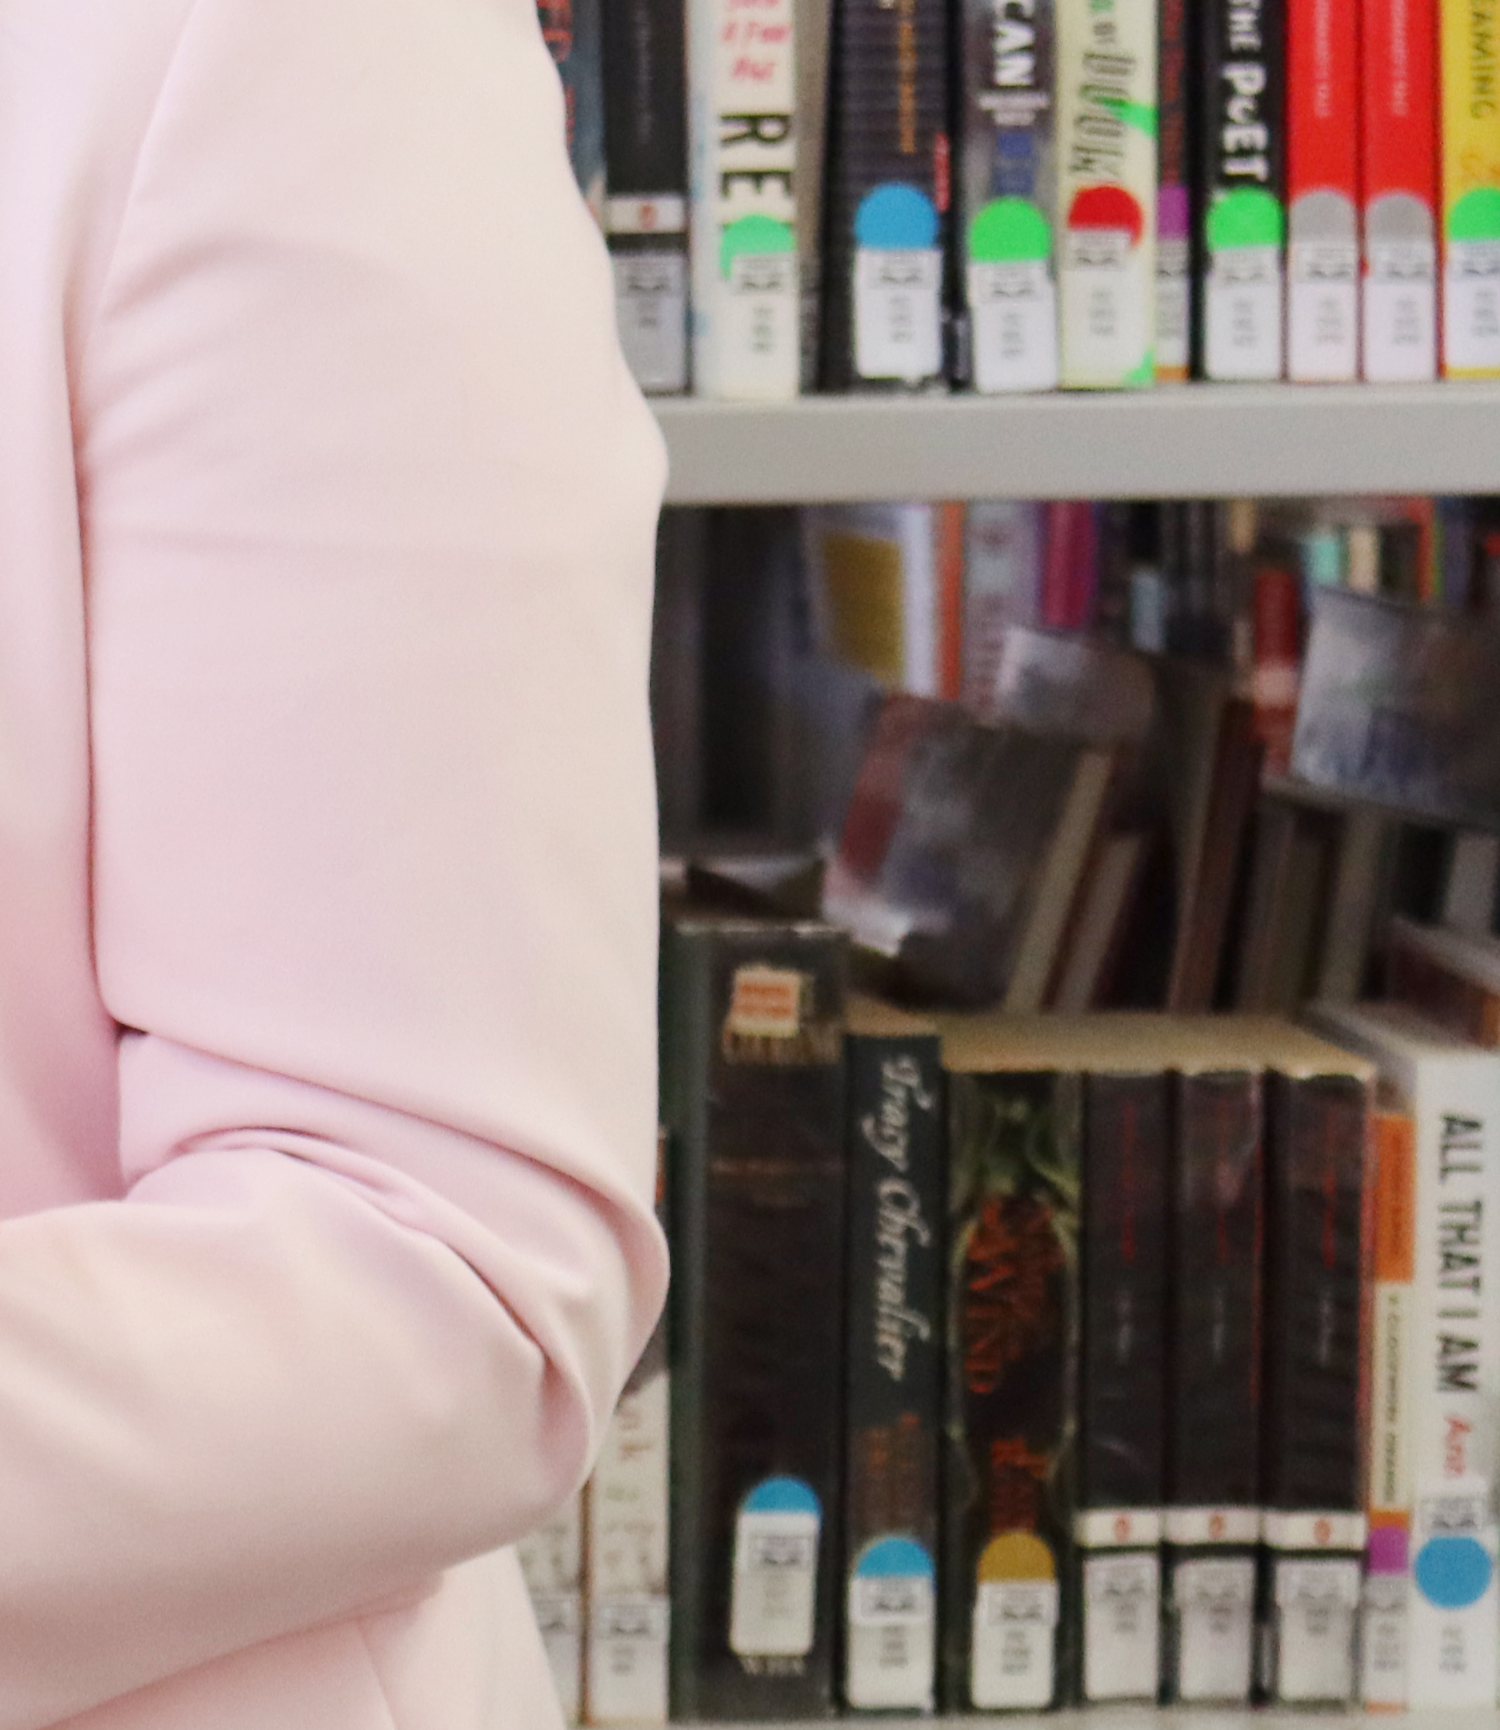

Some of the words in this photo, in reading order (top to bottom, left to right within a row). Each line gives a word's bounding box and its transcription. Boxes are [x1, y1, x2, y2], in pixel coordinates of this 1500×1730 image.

[860, 1053, 934, 1171] Tracy
[1440, 1114, 1489, 1184] ALL
[875, 1174, 934, 1381] Chevalier
[1438, 1197, 1489, 1299] THAT
[1438, 1307, 1487, 1321] I
[1436, 1331, 1487, 1395] AM
